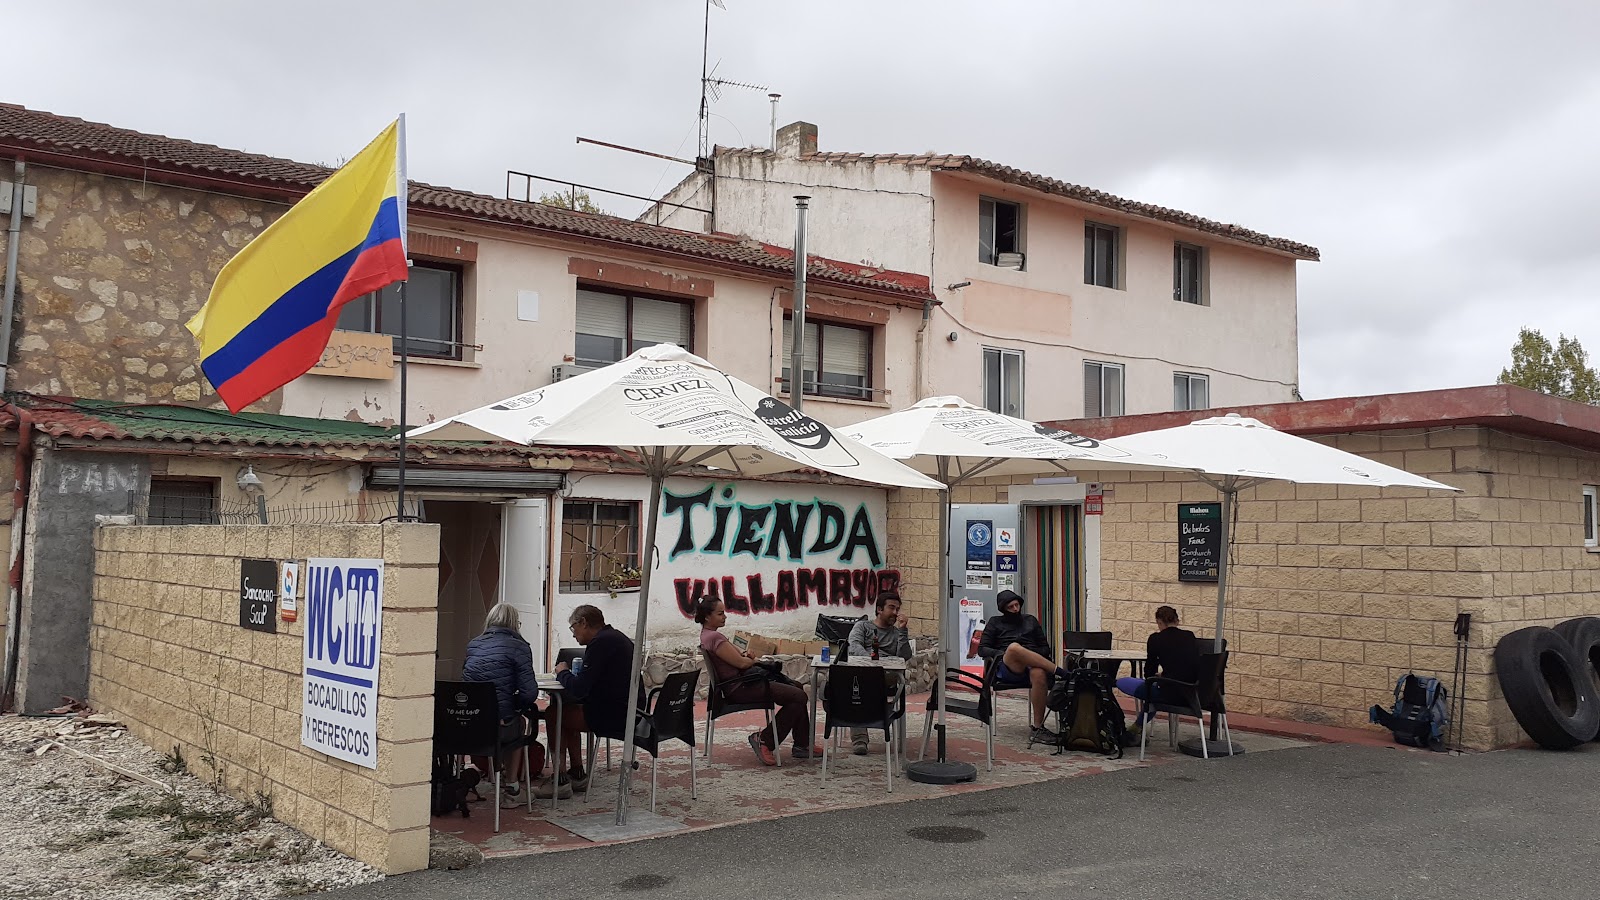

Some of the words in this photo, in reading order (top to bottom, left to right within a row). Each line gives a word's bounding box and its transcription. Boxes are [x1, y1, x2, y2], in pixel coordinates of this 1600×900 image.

[773, 421, 820, 437] Galicia
[59, 463, 138, 494] PAN
[309, 565, 344, 665] WC
[307, 681, 367, 718] BOCADILLOS
[305, 716, 311, 739] Y
[312, 718, 370, 757] REFRESCOS
